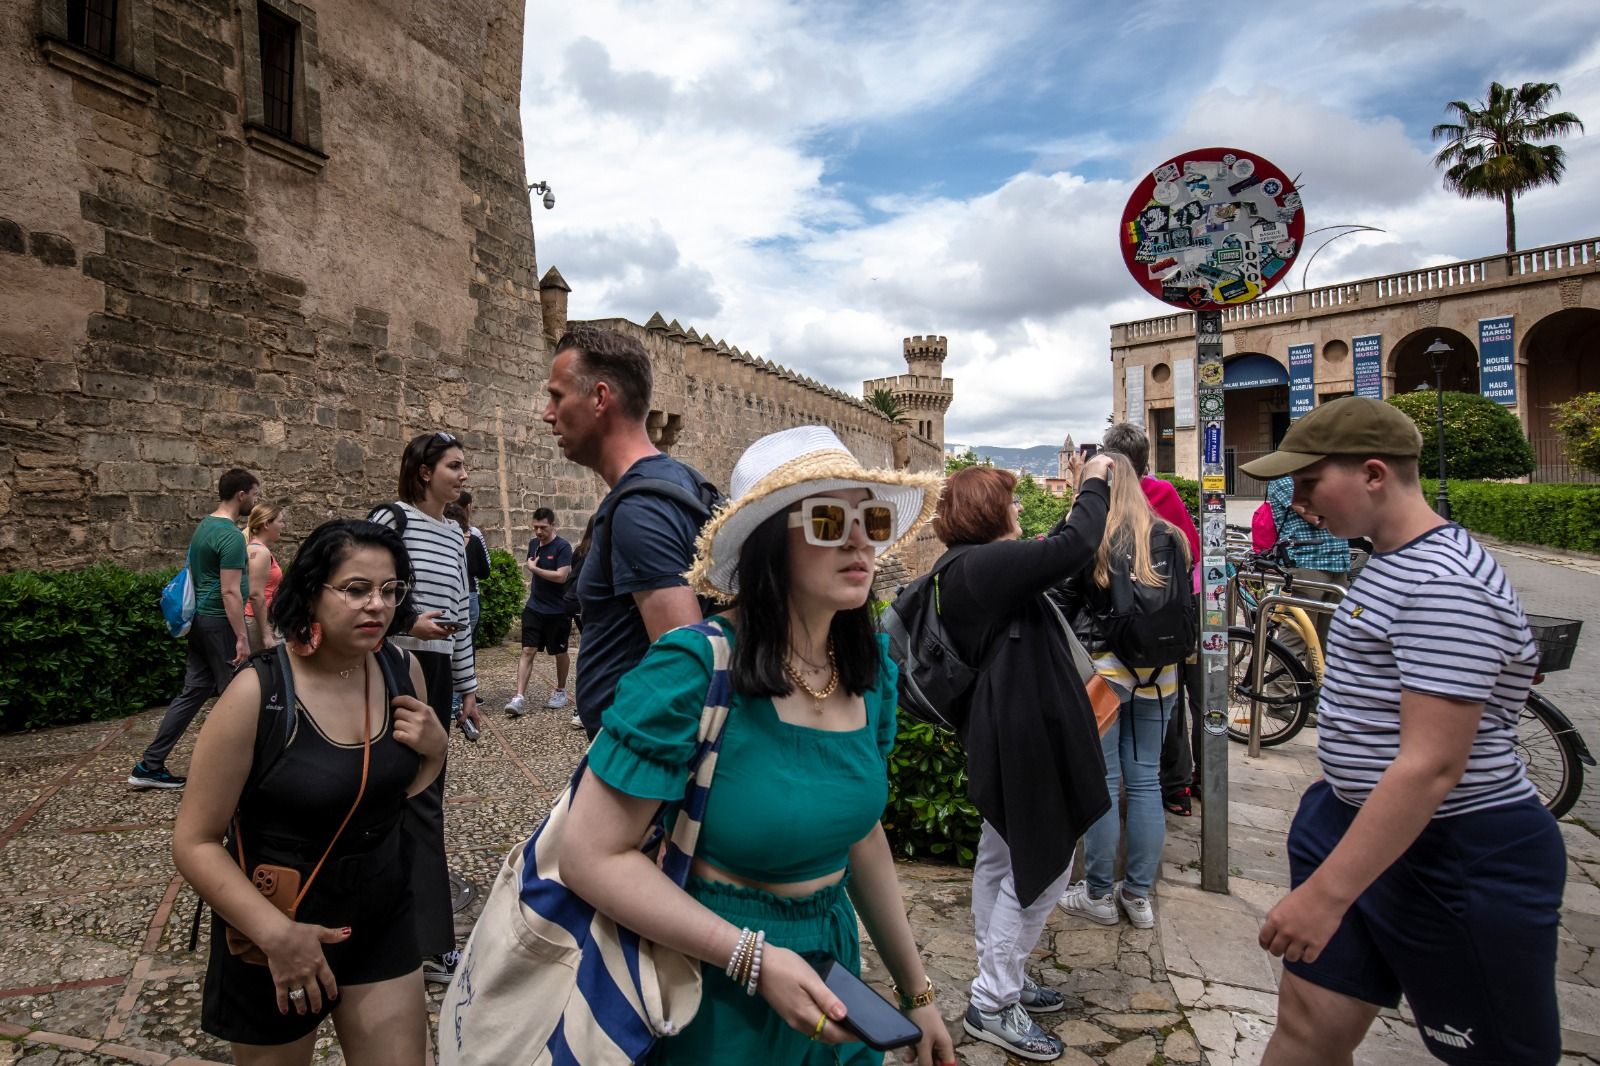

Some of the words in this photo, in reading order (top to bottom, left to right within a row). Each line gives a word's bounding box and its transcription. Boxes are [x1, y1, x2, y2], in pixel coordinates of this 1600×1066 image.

[1483, 322, 1510, 330] PALAU
[1482, 328, 1512, 336] MARCH
[1482, 334, 1512, 343] MUSEO
[1486, 356, 1510, 364] HOUSE
[1484, 364, 1513, 372] MUSEUM
[1484, 389, 1514, 397] MUSEUM
[1424, 1025, 1468, 1048] PUMA
